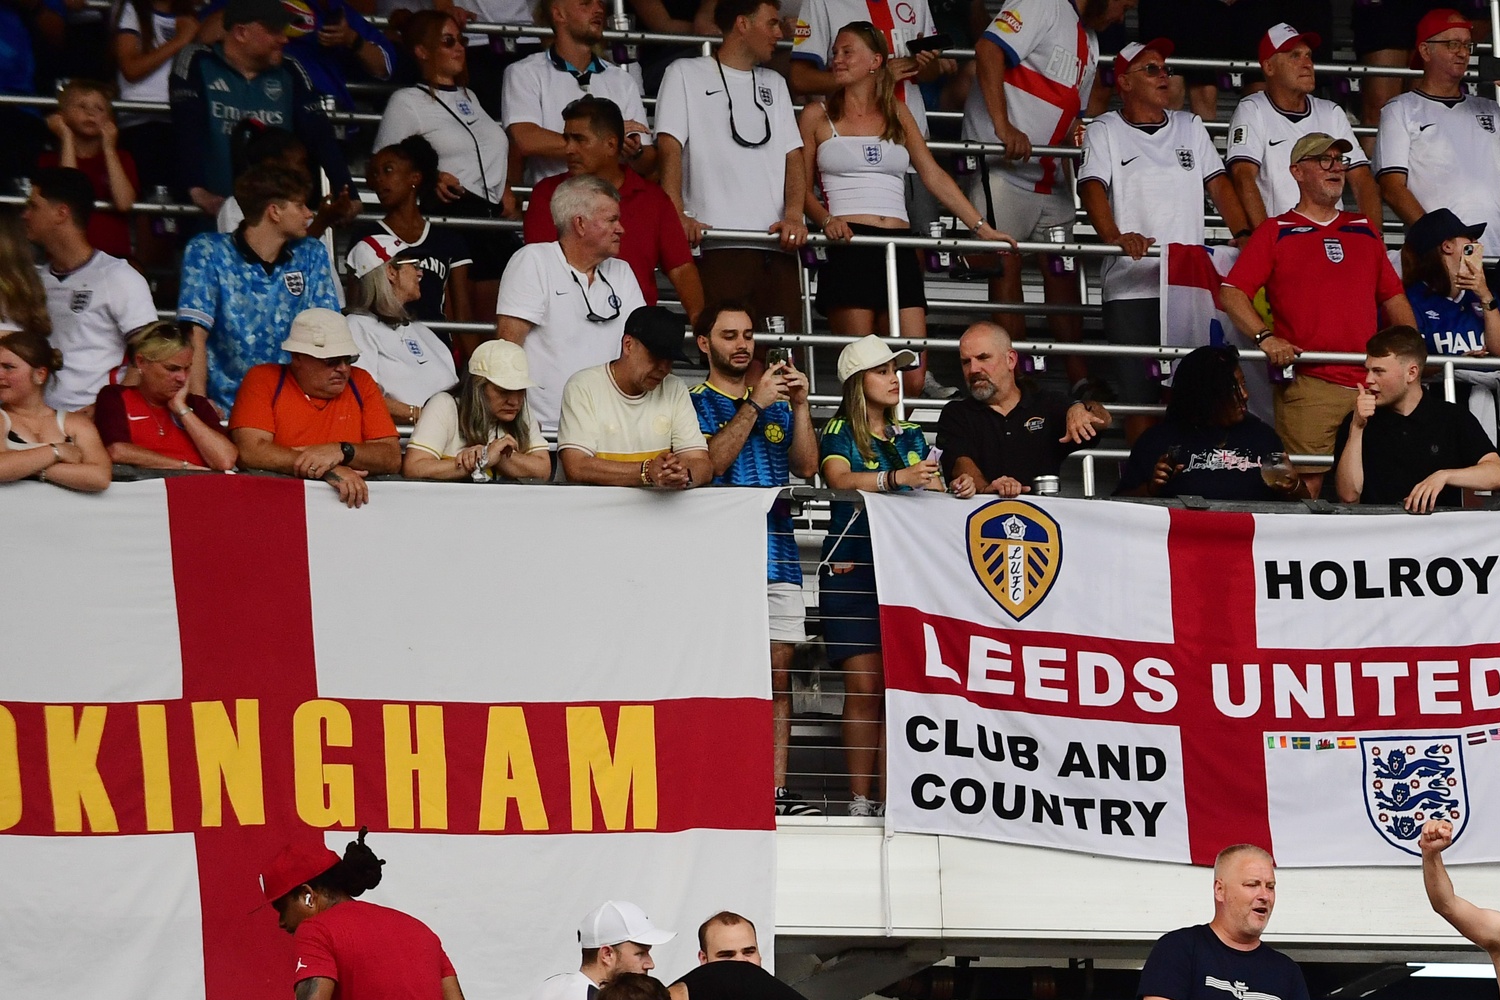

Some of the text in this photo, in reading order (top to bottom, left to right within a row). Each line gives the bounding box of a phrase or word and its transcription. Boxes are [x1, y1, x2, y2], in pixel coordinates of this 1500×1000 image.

[1008, 546, 1022, 602] LUFC
[923, 622, 1179, 713] LEEDS
[905, 715, 1168, 783] CLUB AND
[910, 773, 1168, 838] COUNTRY
